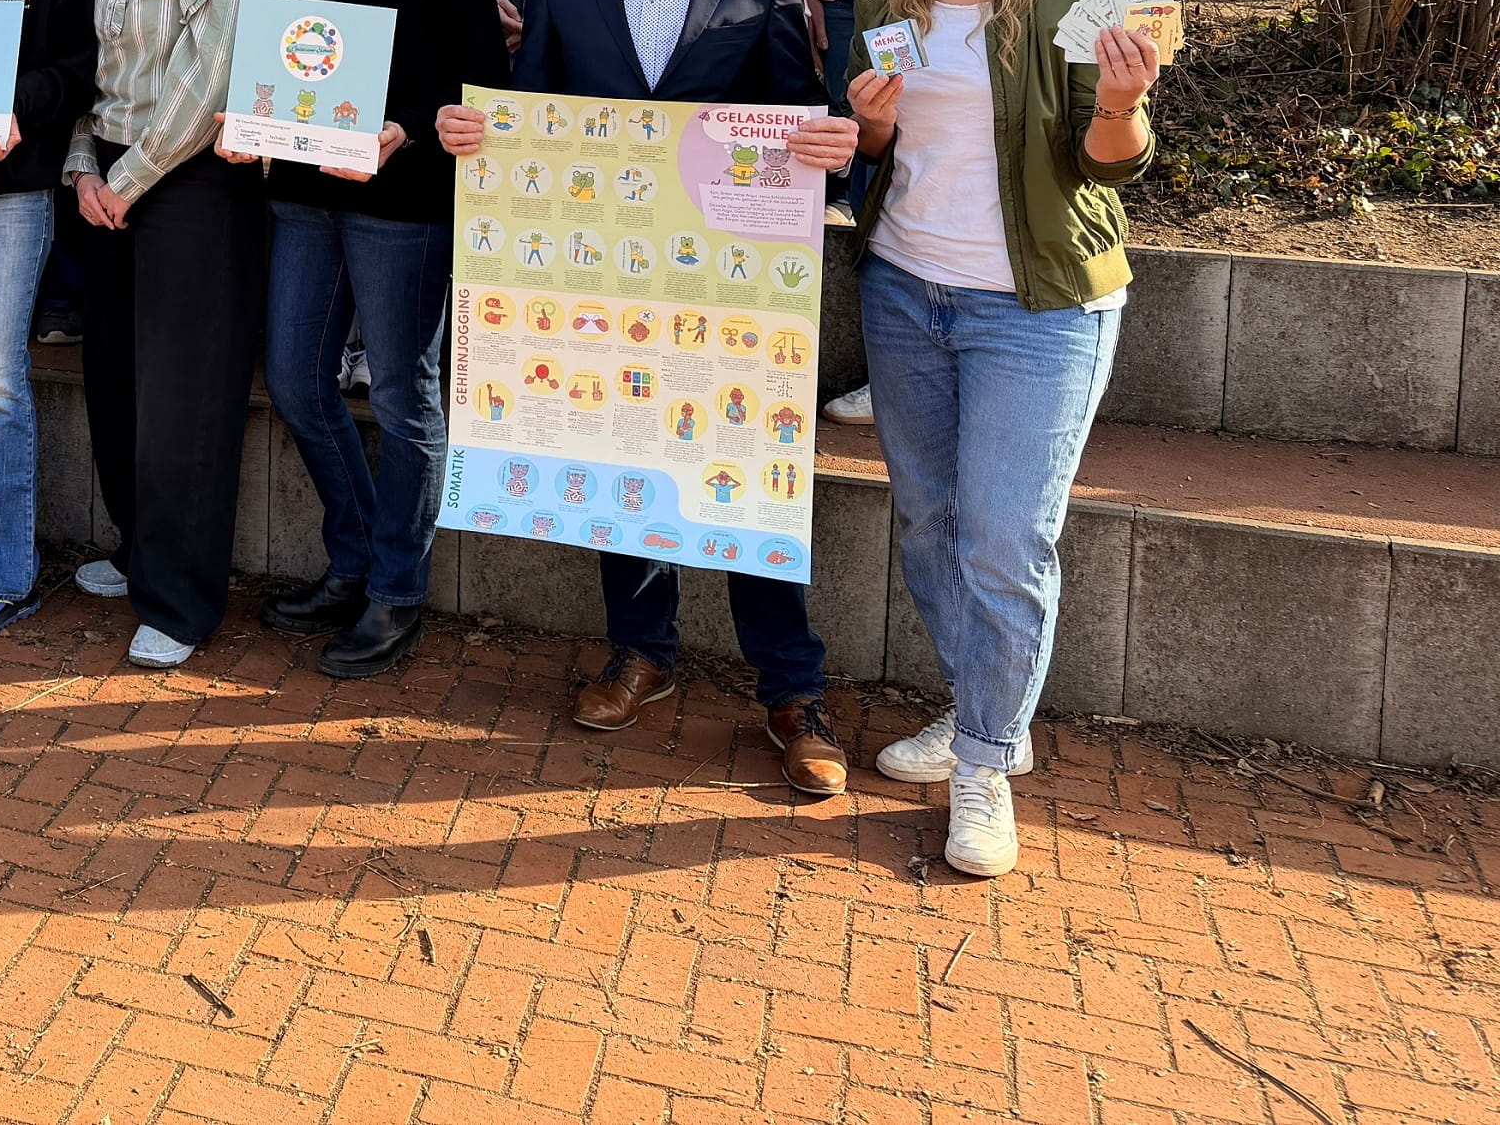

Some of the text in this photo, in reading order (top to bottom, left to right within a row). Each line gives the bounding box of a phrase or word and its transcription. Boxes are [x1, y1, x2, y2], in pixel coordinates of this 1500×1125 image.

[716, 111, 804, 126] GELASSENE
[730, 126, 789, 140] SCHULE
[456, 288, 470, 405] GEHIRNJOGGING
[447, 449, 465, 509] SOMATIK
